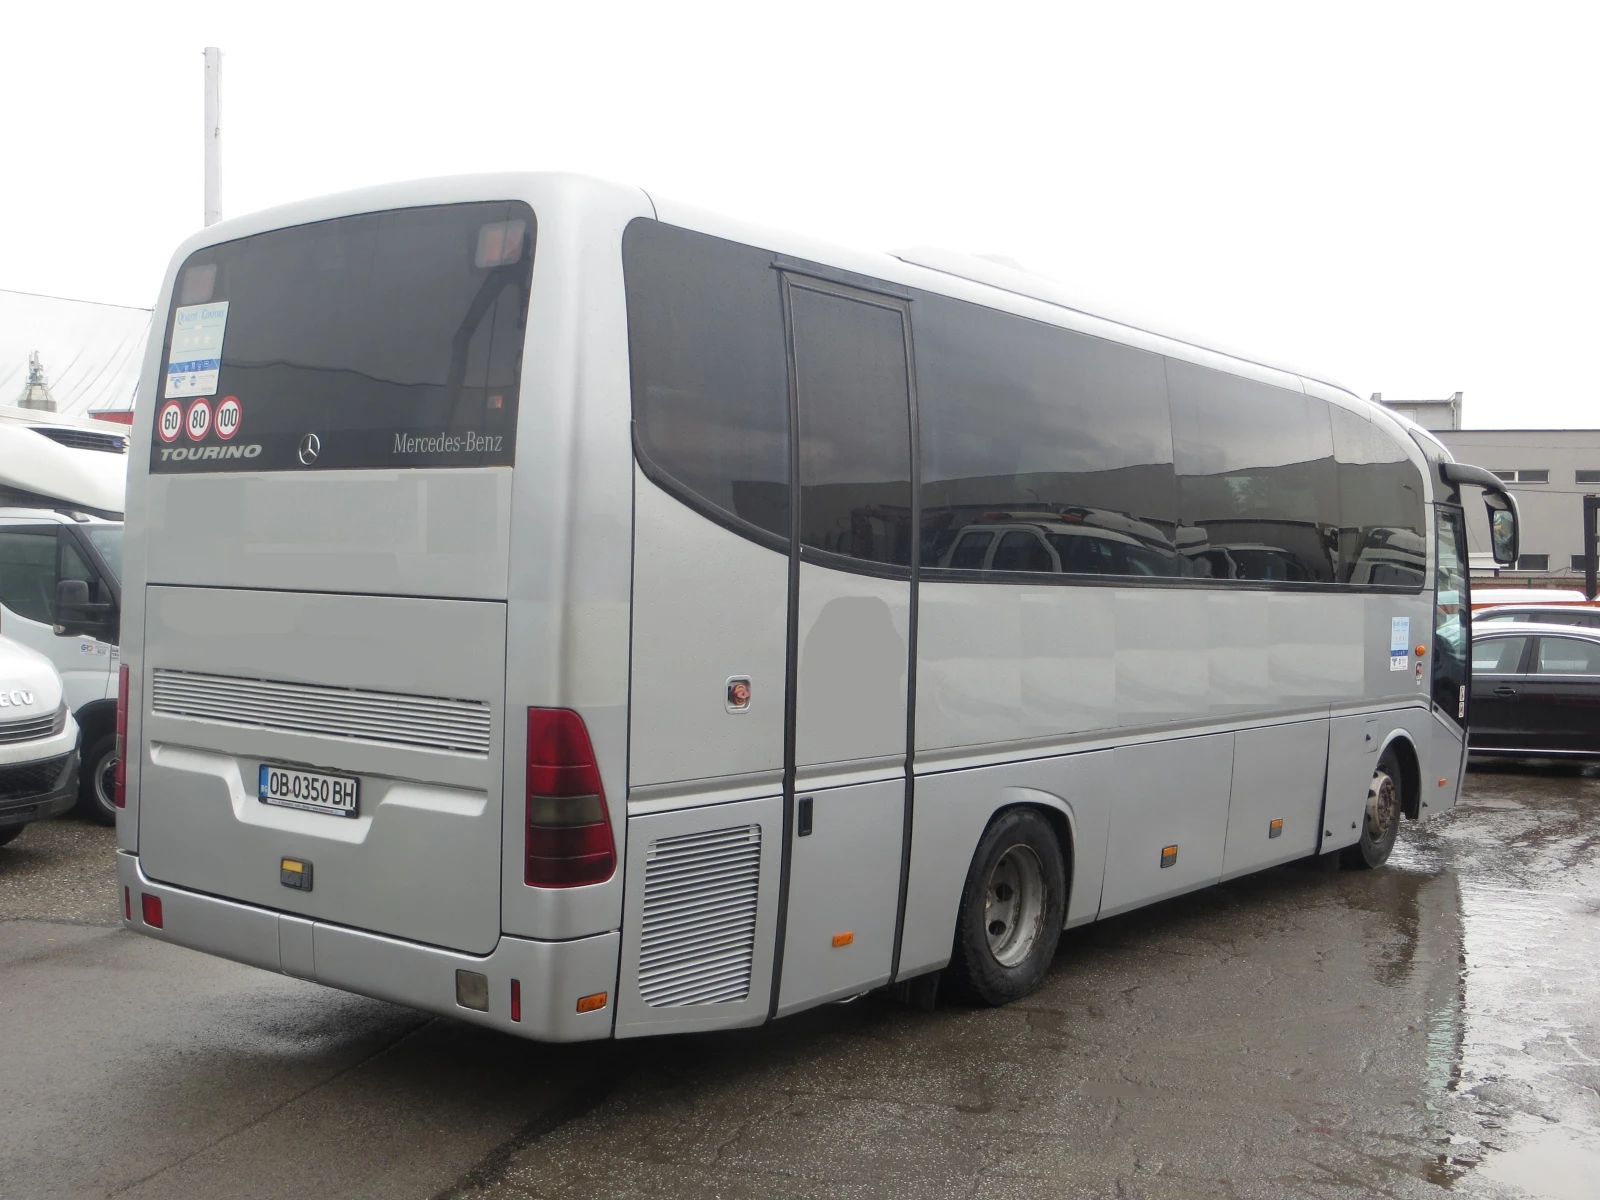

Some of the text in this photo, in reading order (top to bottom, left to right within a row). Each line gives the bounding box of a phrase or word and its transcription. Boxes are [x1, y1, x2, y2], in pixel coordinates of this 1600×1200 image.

[164, 411, 179, 430] 60
[191, 409, 206, 429] 80
[220, 408, 238, 427] 100
[393, 431, 503, 454] Mercedes-Benz
[160, 444, 263, 462] TOURINO
